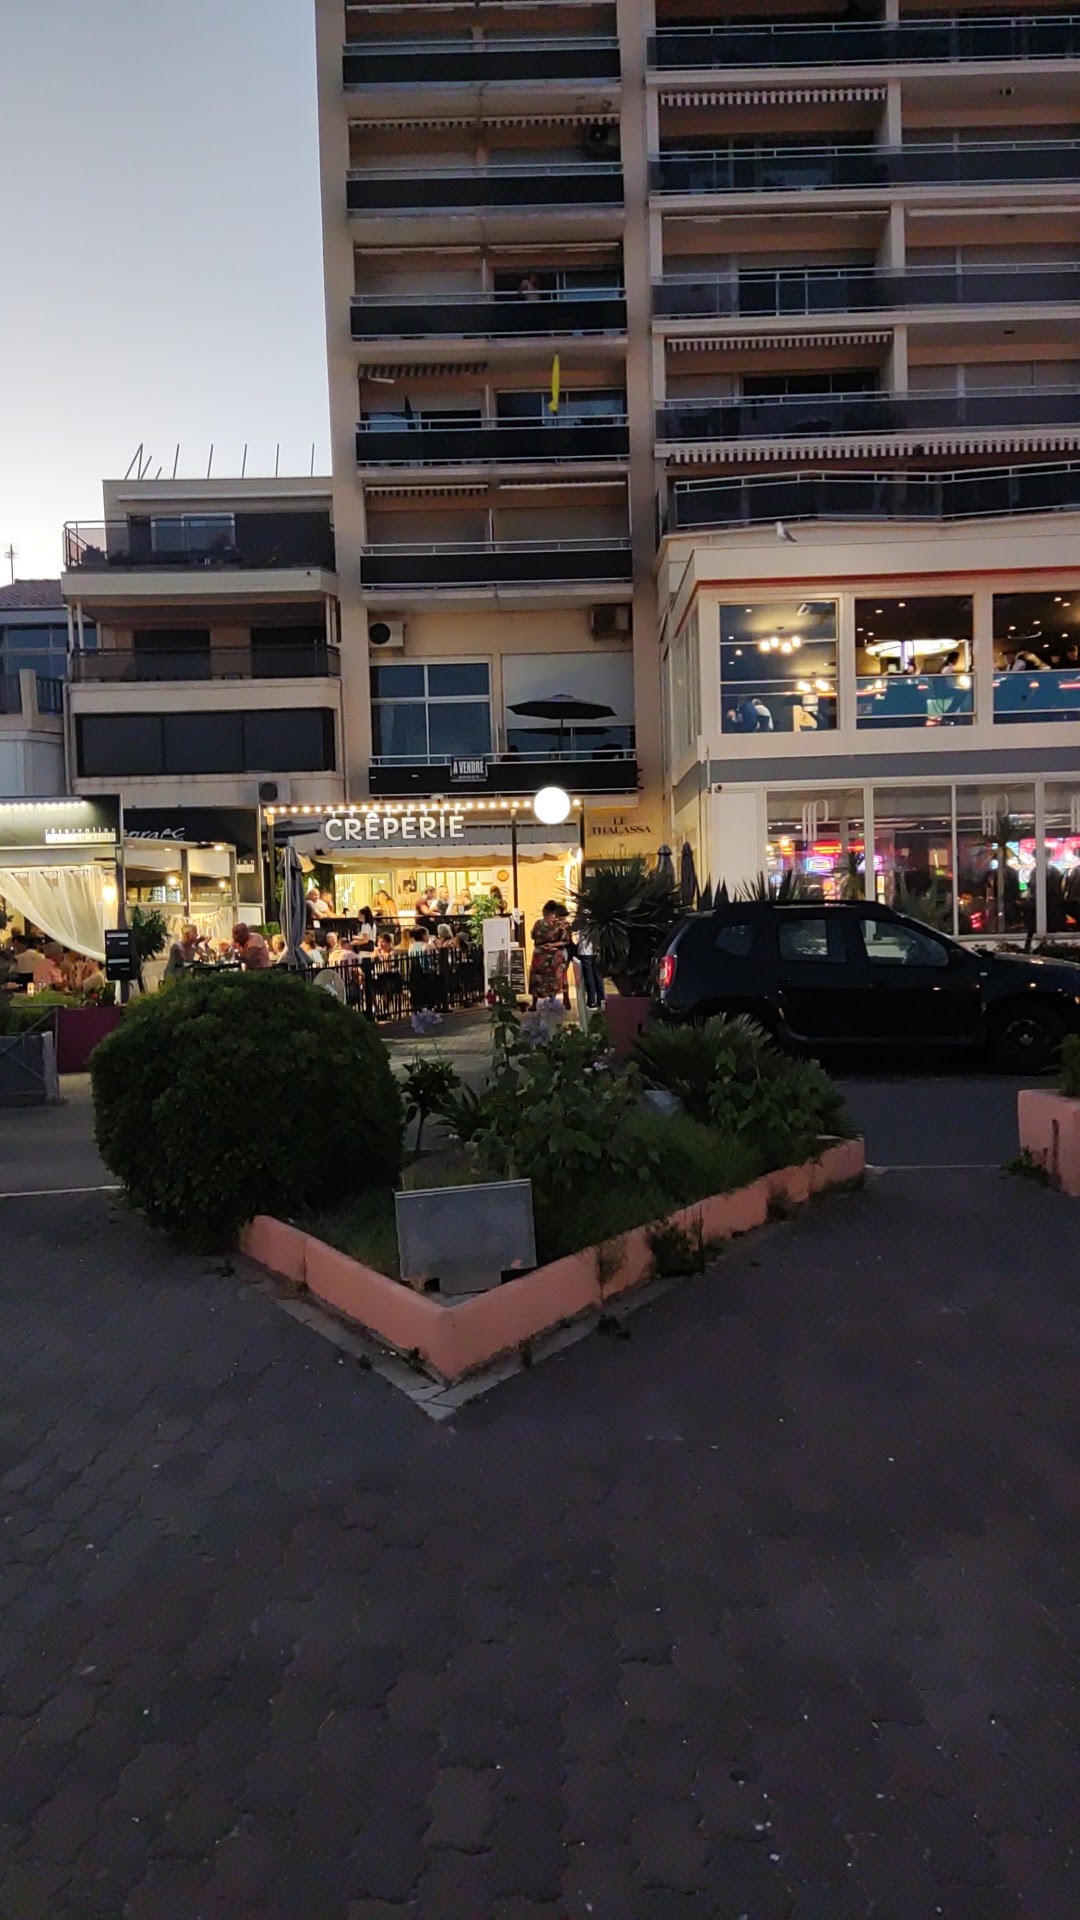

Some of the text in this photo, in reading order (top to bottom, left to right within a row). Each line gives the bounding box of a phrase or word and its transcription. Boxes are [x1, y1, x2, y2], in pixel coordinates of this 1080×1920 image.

[459, 760, 484, 774] VENDRE
[325, 811, 465, 842] CRÊPERIE
[613, 816, 628, 825] LE
[592, 825, 652, 836] THALASSA
